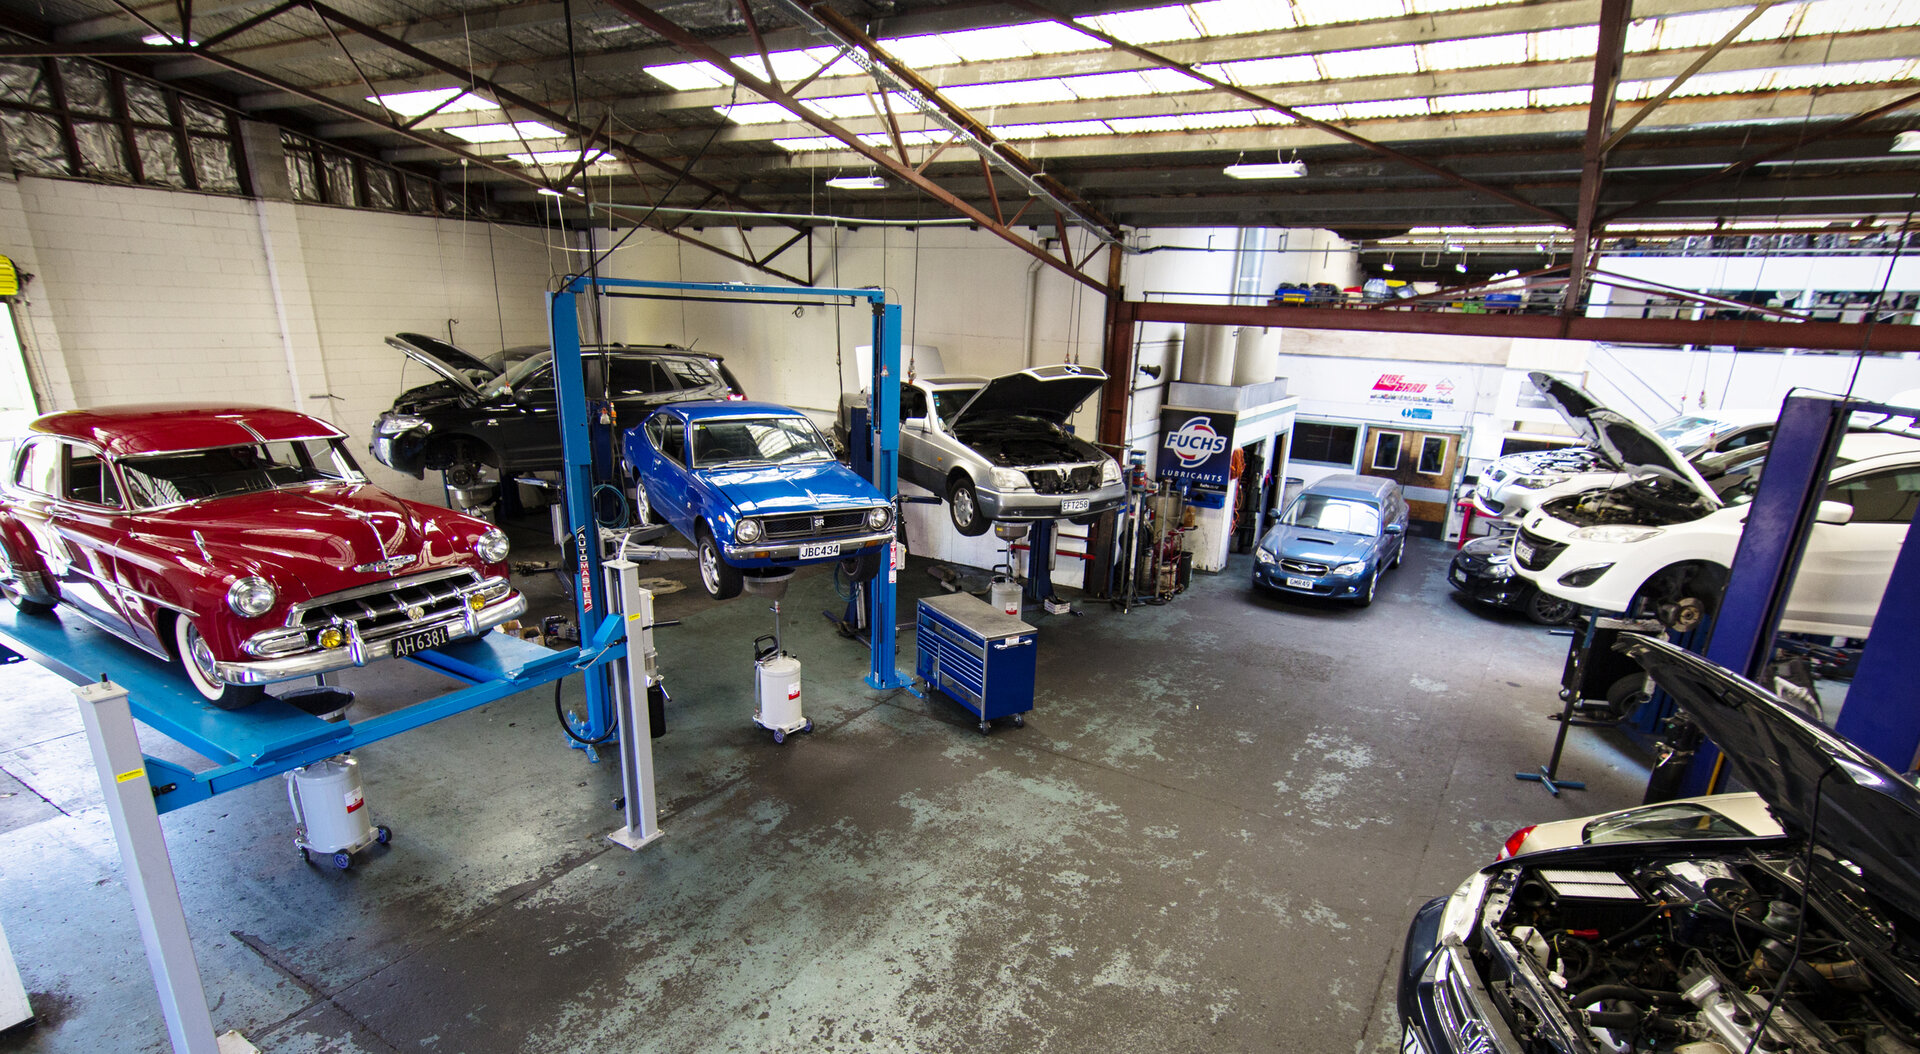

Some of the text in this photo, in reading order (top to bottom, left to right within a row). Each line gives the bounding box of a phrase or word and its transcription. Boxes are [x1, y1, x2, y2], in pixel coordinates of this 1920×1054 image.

[1166, 434, 1224, 452] FUCHS
[1161, 468, 1222, 482] LUBRICANTS
[814, 518, 825, 527] SR
[801, 544, 839, 558] JBC434
[578, 533, 592, 605] AUTOMASTER
